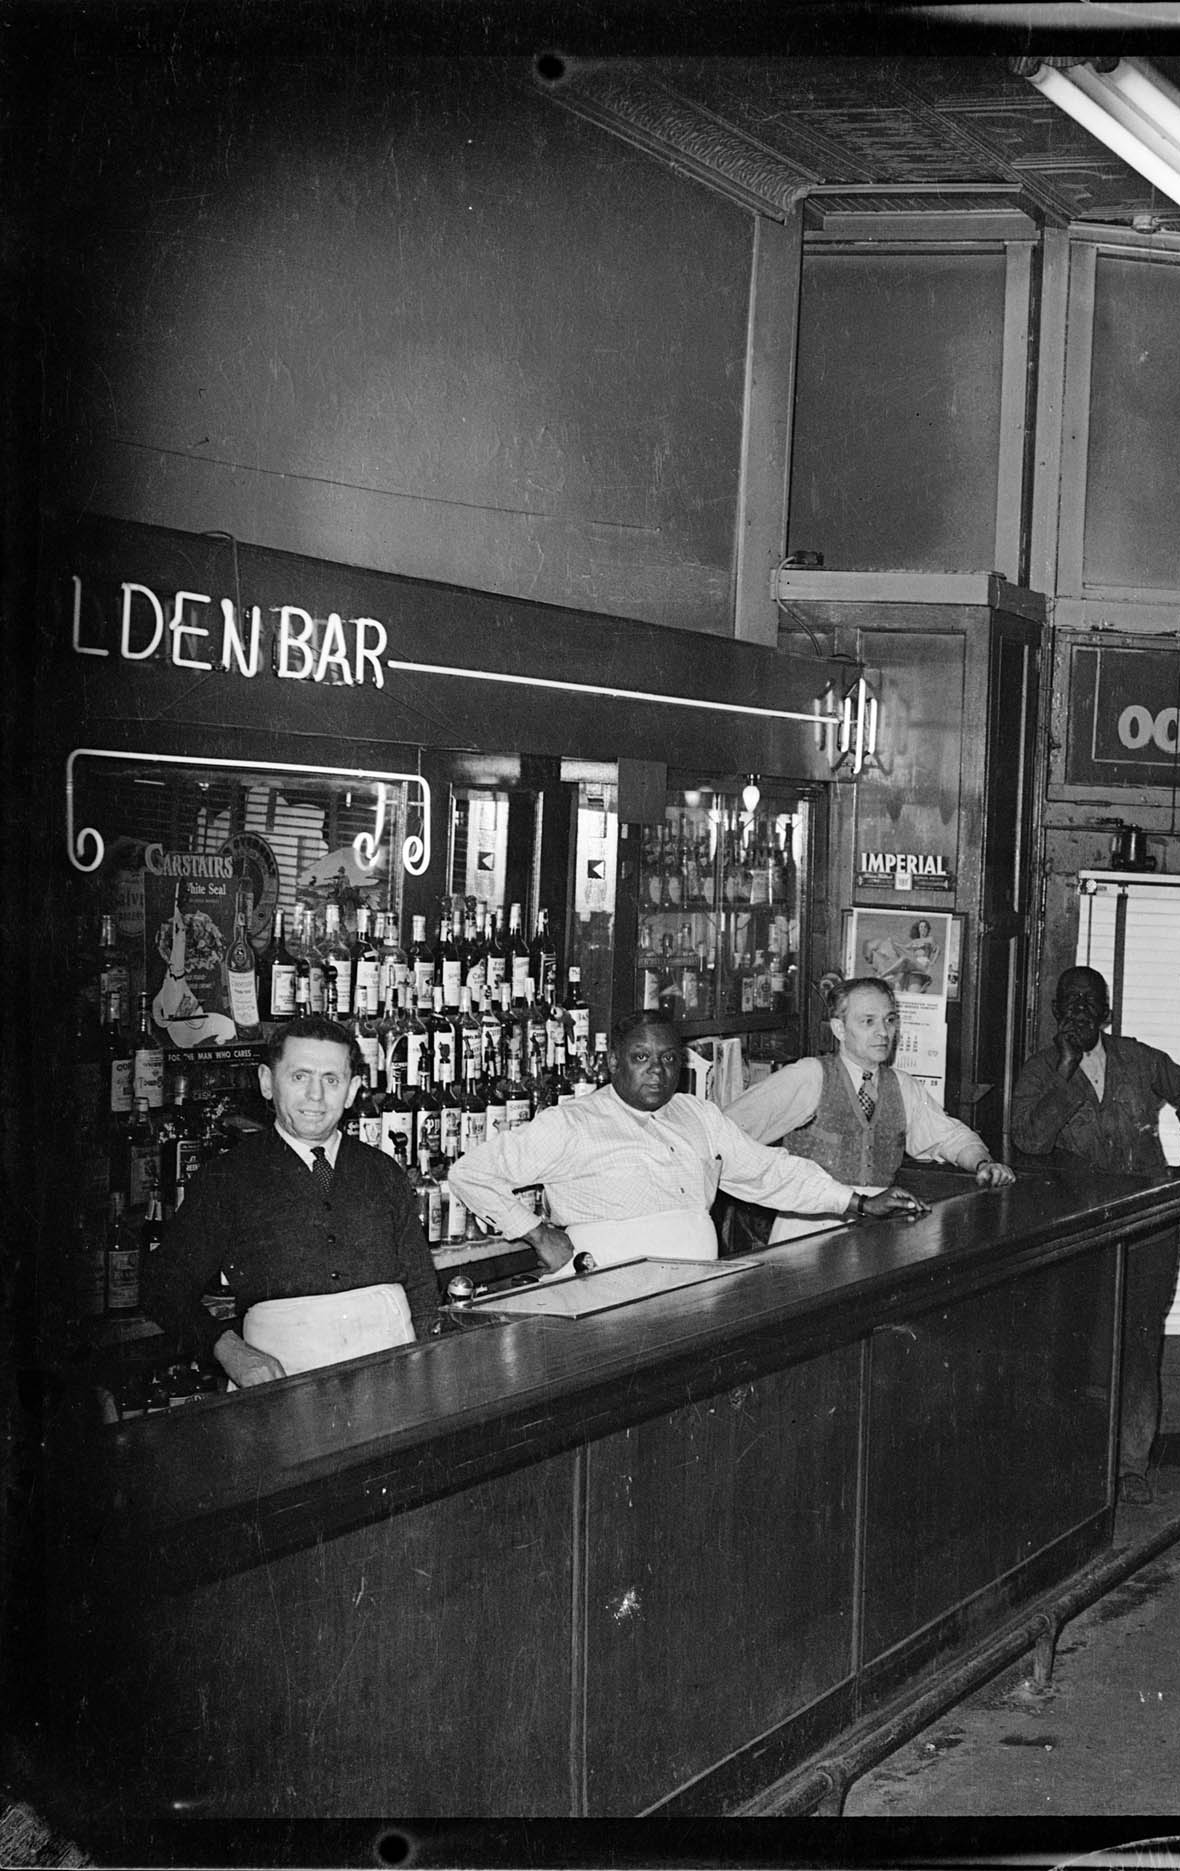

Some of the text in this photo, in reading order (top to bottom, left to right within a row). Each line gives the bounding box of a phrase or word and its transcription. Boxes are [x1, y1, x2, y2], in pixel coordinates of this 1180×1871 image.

[277, 605, 386, 689] BAR
[145, 843, 234, 879] CARSTAIRS
[861, 852, 947, 876] IMPERIAL
[208, 881, 227, 896] Seal
[197, 1051, 213, 1061] MAN
[215, 1050, 232, 1060] WHO
